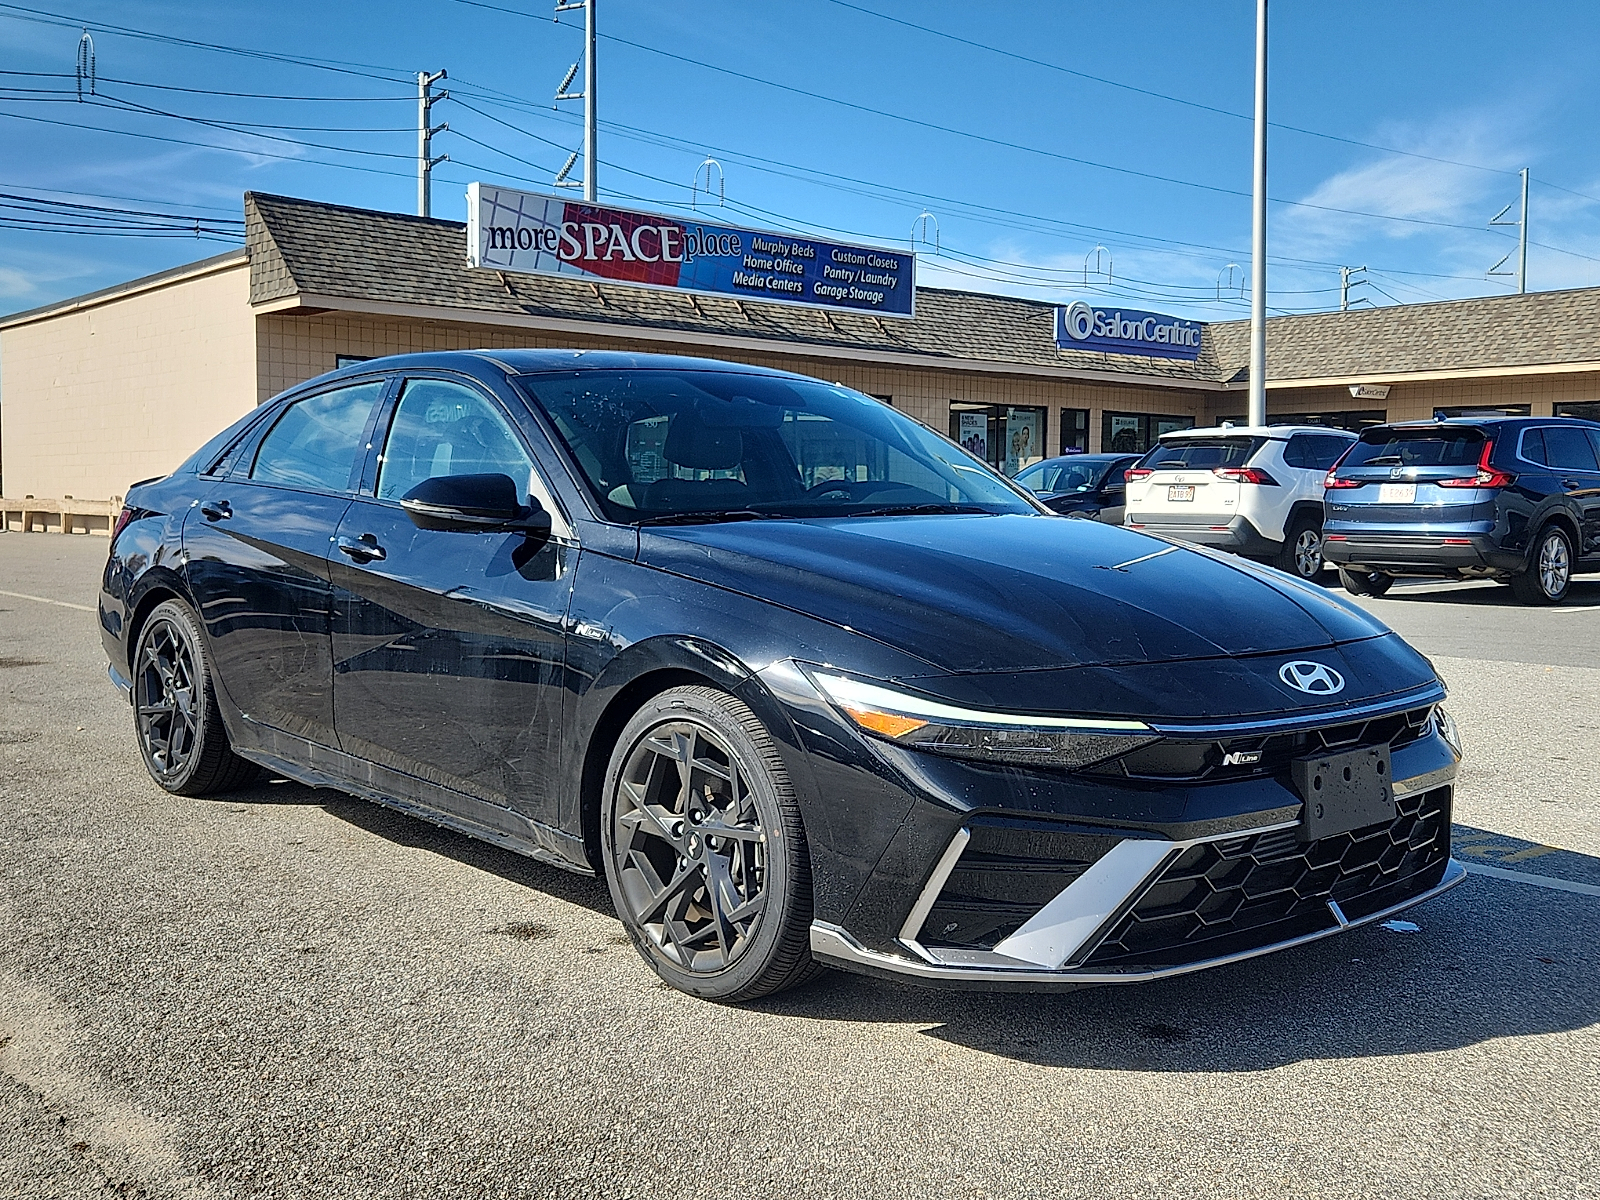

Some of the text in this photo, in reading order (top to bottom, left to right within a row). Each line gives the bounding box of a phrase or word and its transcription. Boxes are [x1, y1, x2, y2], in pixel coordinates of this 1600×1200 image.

[751, 237, 815, 258] Murphy Beds
[743, 254, 804, 274] Home Office
[831, 249, 898, 270] Custom Closets
[732, 271, 803, 292] Media Centers
[823, 265, 855, 284] Pantry
[860, 270, 898, 290] Laundry
[813, 282, 884, 305] Garage Storage
[1093, 310, 1200, 347] SalonCentric
